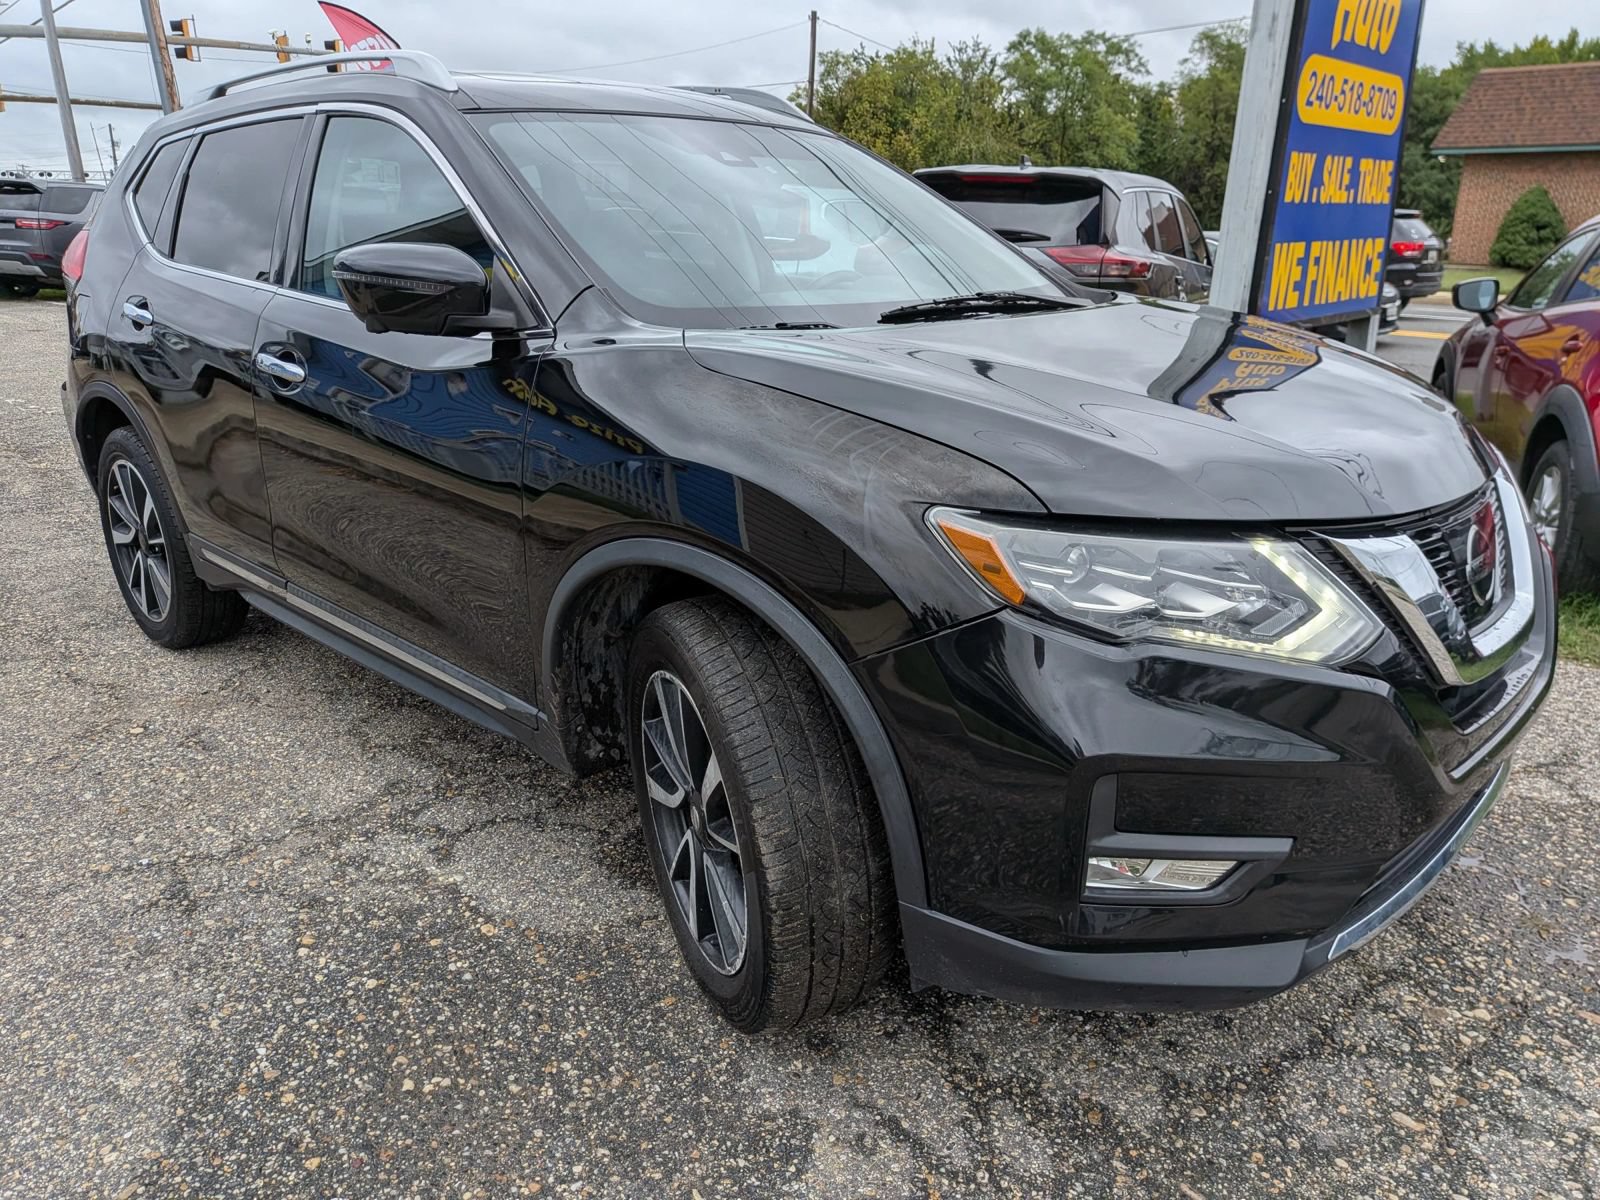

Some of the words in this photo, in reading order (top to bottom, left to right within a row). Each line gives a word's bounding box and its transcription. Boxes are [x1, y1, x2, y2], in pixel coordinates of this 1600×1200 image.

[1305, 71, 1397, 120] 240-518-8709
[1357, 158, 1394, 204] TRADE
[1268, 241, 1306, 311] WE
[1303, 237, 1385, 307] FINANCE
